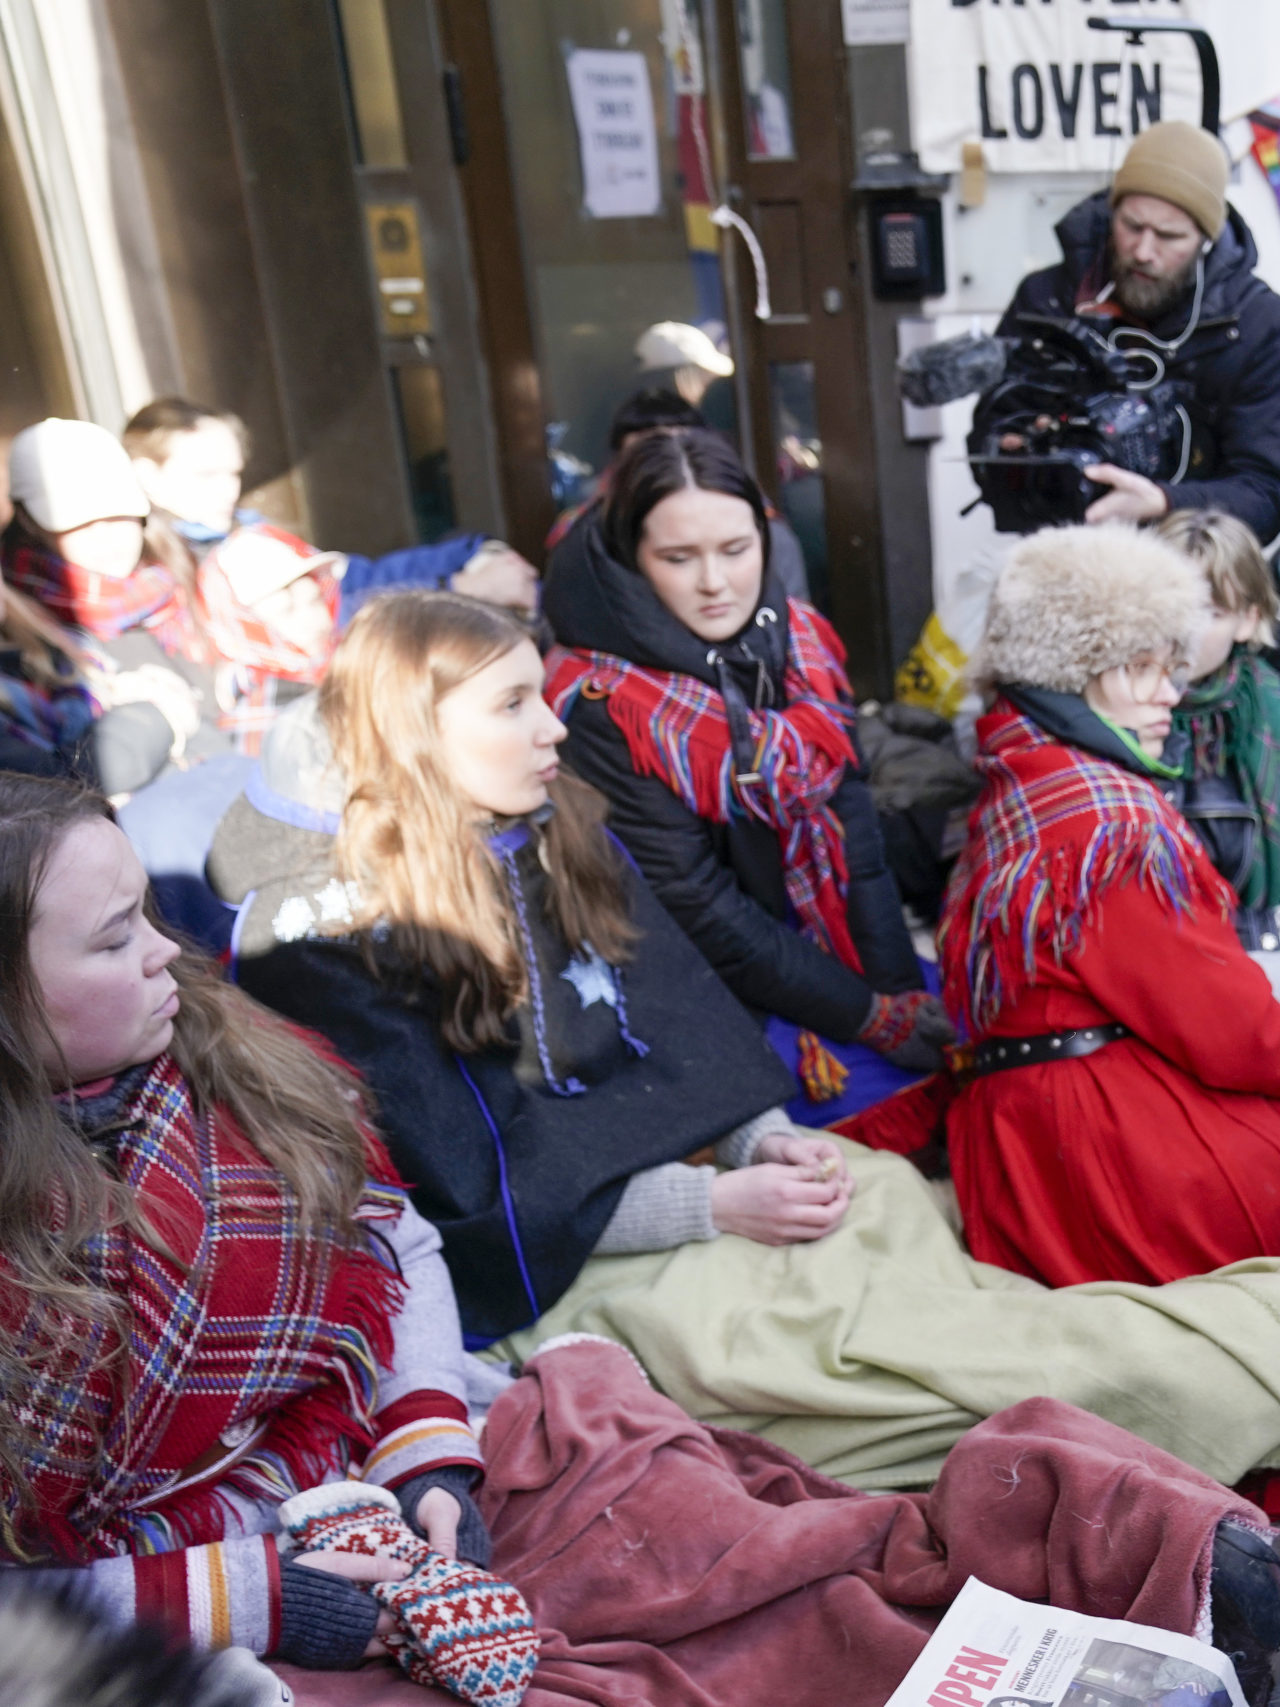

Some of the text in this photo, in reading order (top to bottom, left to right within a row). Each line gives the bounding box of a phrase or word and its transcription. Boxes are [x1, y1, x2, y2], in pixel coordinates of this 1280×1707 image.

[978, 62, 1162, 139] LOVEN
[1014, 1649, 1047, 1693] MENNESKER
[1041, 1628, 1057, 1647] KRIG
